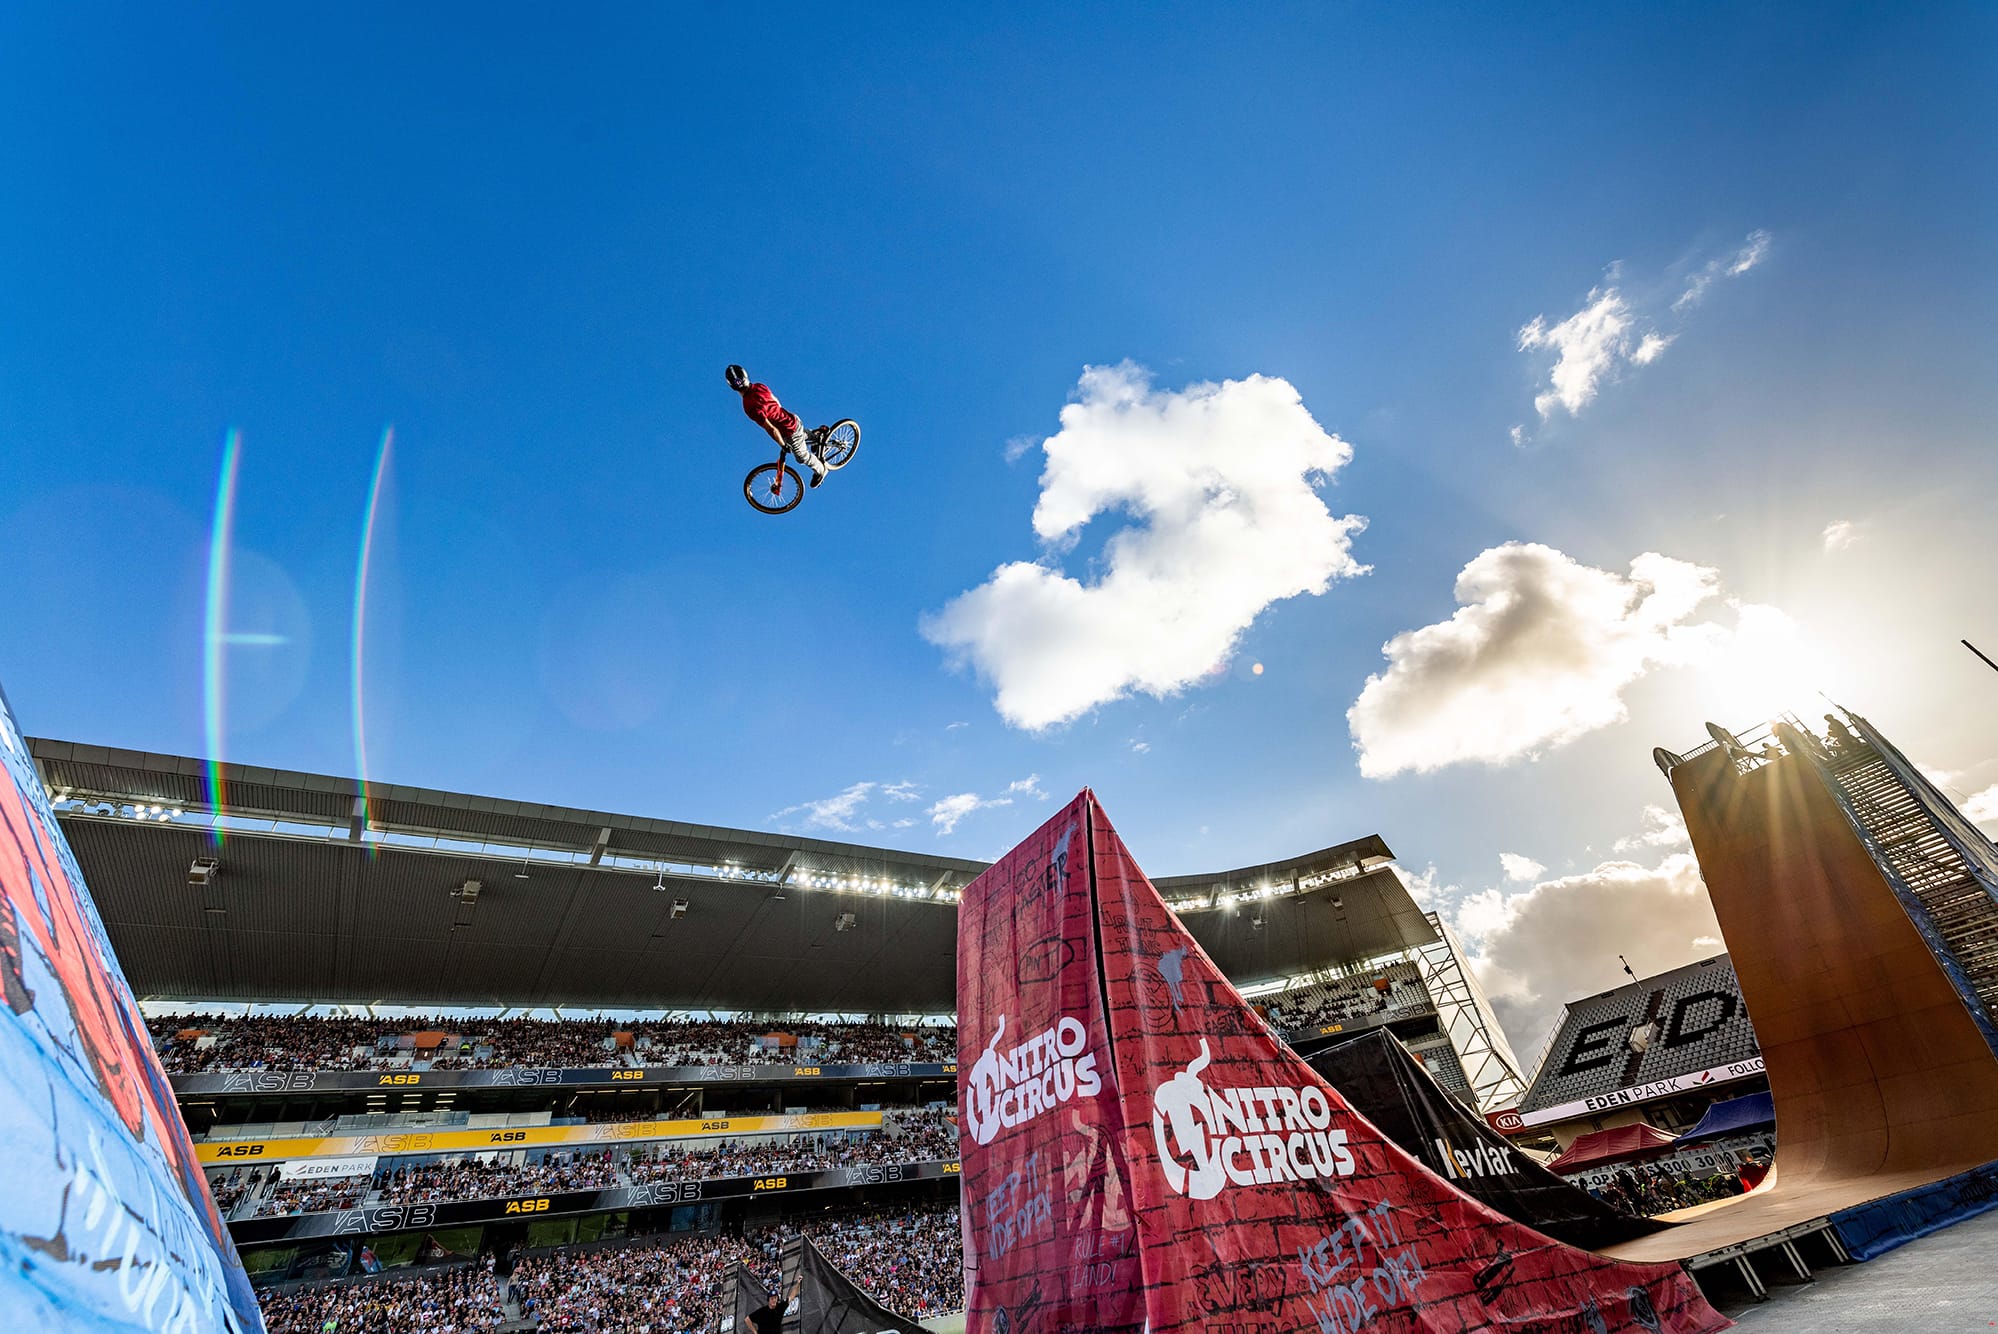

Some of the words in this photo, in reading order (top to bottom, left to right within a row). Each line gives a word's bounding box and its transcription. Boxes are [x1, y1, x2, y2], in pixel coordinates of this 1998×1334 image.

[1380, 1003, 1427, 1024] ASB
[1320, 1024, 1343, 1035] ASB
[999, 1017, 1086, 1081] NITRO
[492, 1068, 563, 1086] ASB
[612, 1071, 644, 1080] ASB
[700, 1065, 756, 1081] ASB
[794, 1067, 821, 1076] ASB
[865, 1063, 911, 1077] ASB
[942, 1065, 957, 1073] AS
[221, 1072, 316, 1092] ASB
[379, 1074, 421, 1085] ASB
[999, 1052, 1100, 1128] CIRCUS
[1585, 1090, 1631, 1111] EDEN
[1634, 1078, 1683, 1100] PARK
[1207, 1084, 1331, 1134] NITRO
[701, 1121, 730, 1131] ASB
[784, 1113, 833, 1129] ASB
[1499, 1116, 1522, 1128] KIA
[490, 1132, 526, 1142] ASB
[593, 1122, 657, 1141] ASB
[216, 1145, 265, 1157] ASB
[353, 1133, 434, 1153] ASB
[1220, 1129, 1356, 1185] CIRCUS
[308, 1165, 339, 1174] EDEN
[341, 1162, 372, 1173] PARK
[845, 1164, 903, 1185] ASB
[942, 1162, 960, 1173] AS
[1025, 1151, 1039, 1193] IT
[753, 1177, 787, 1190] ASB
[626, 1182, 701, 1207] ASB
[505, 1198, 550, 1214] ASB
[1017, 1187, 1052, 1238] OPEN
[332, 1203, 436, 1236] ASB
[1075, 1234, 1104, 1259] RULE
[1298, 1217, 1367, 1293] KEEP
[1368, 1198, 1399, 1249] IT
[1073, 1263, 1117, 1288] LAND!
[1300, 1276, 1378, 1334] WIDE
[1373, 1242, 1427, 1306] OPEN
